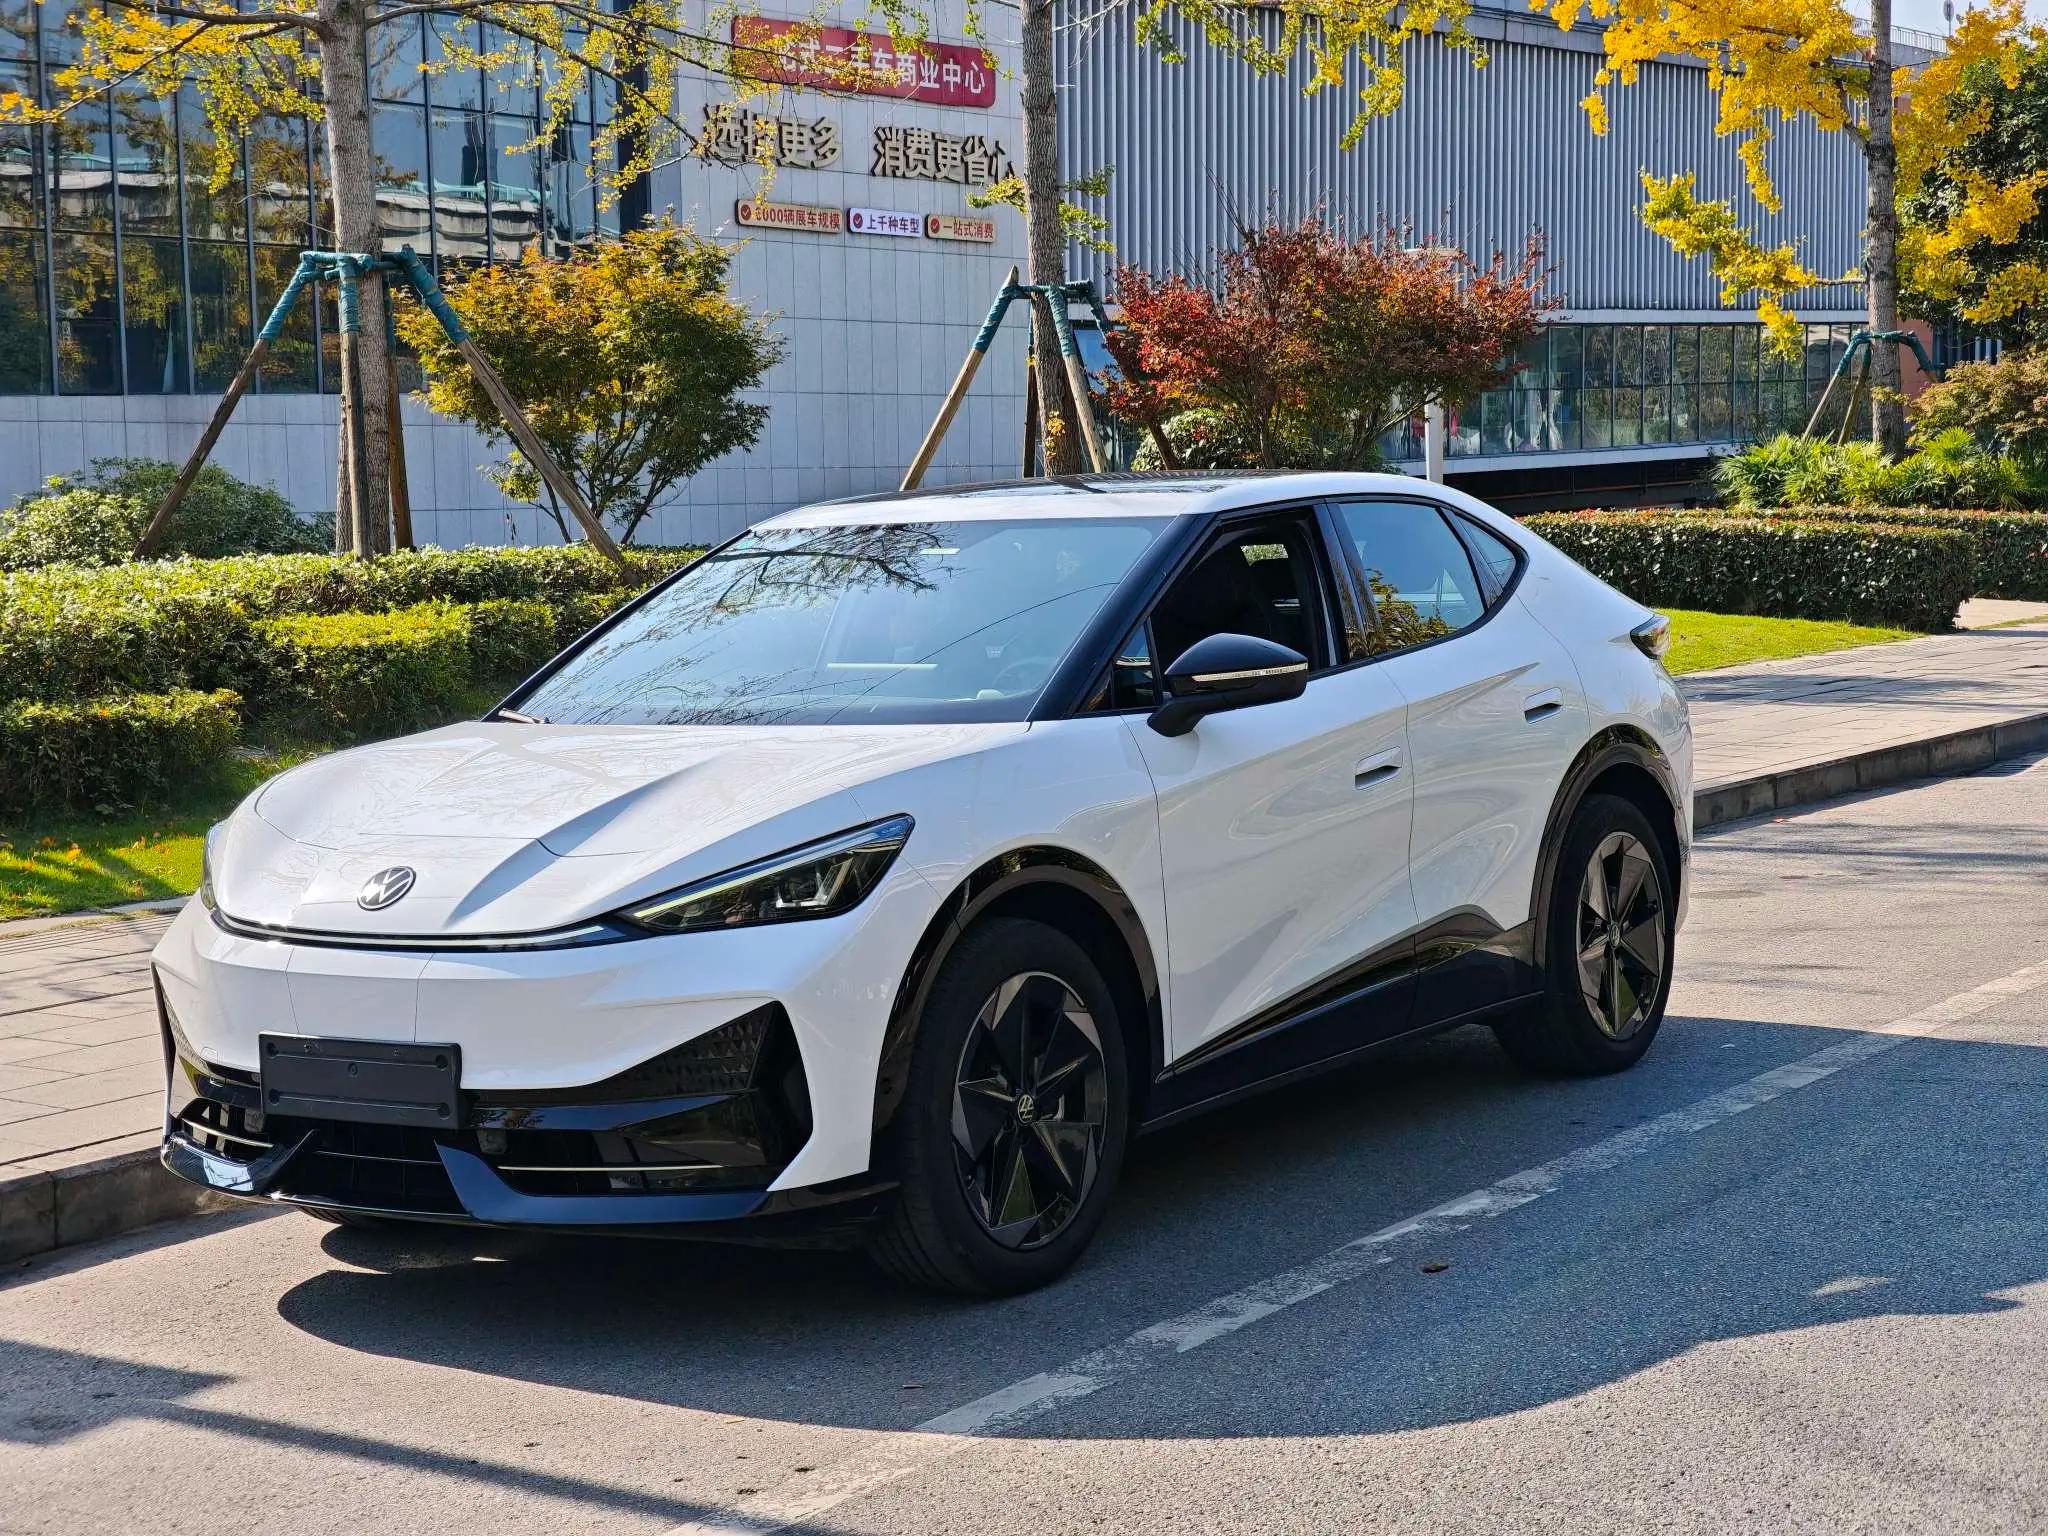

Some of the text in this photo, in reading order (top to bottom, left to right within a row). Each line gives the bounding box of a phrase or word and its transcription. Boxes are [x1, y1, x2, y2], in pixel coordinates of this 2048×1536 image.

[764, 36, 986, 94] 式二手车商业中心
[872, 126, 1016, 185] 消费更省心
[867, 213, 920, 235] 上千种车型
[943, 218, 994, 240] 一站式消费
